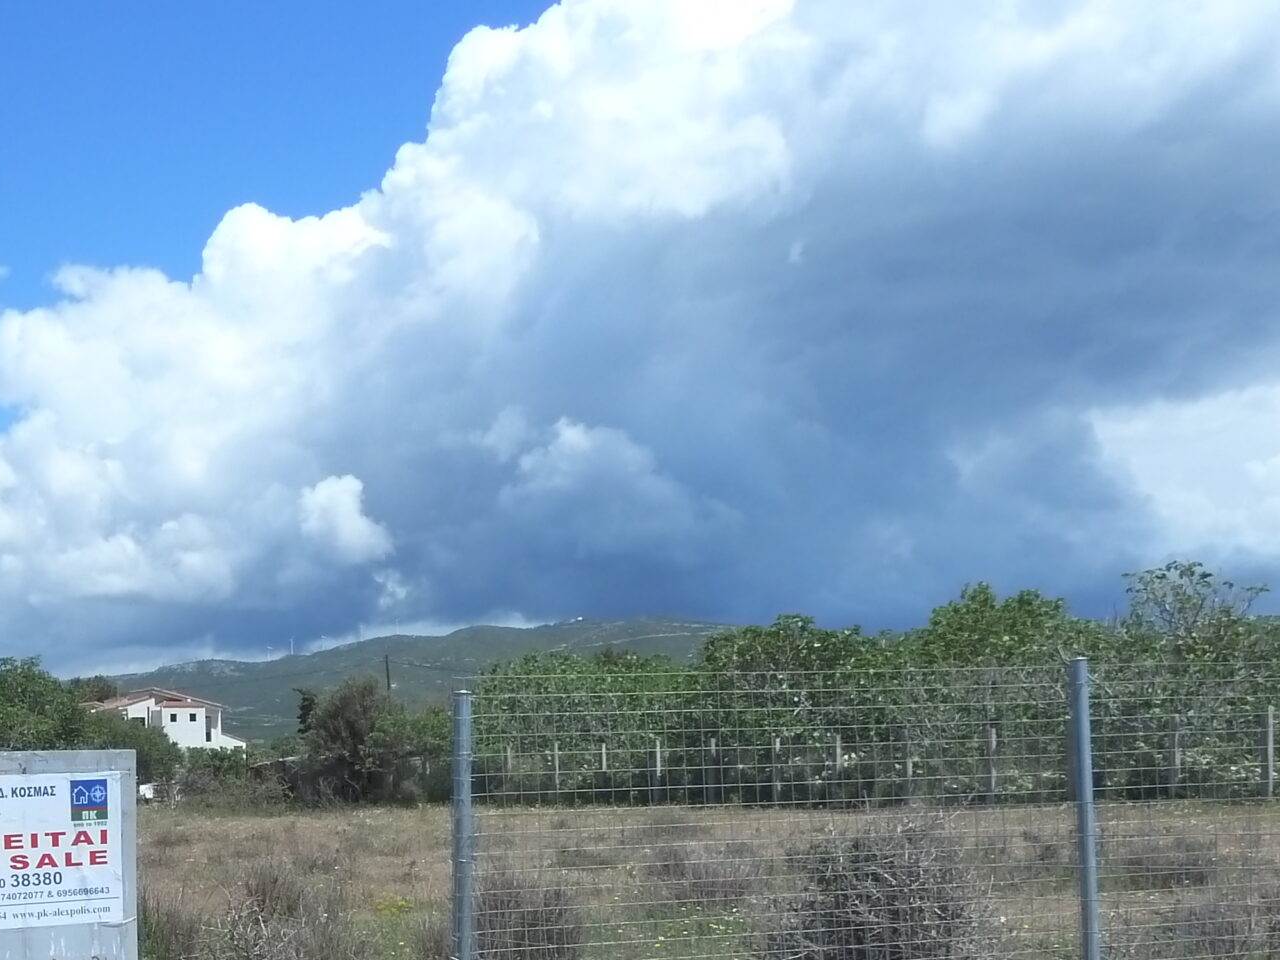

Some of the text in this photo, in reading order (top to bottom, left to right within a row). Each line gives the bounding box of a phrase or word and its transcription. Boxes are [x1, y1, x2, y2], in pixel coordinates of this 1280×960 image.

[11, 786, 56, 798] ΚΟΣΜΑΣ
[81, 811, 98, 820] ΠΚ
[10, 850, 108, 870] SALE
[10, 872, 62, 887] 38380
[47, 890, 54, 898] &
[12, 905, 111, 920] www.pk-alexpolis.com
